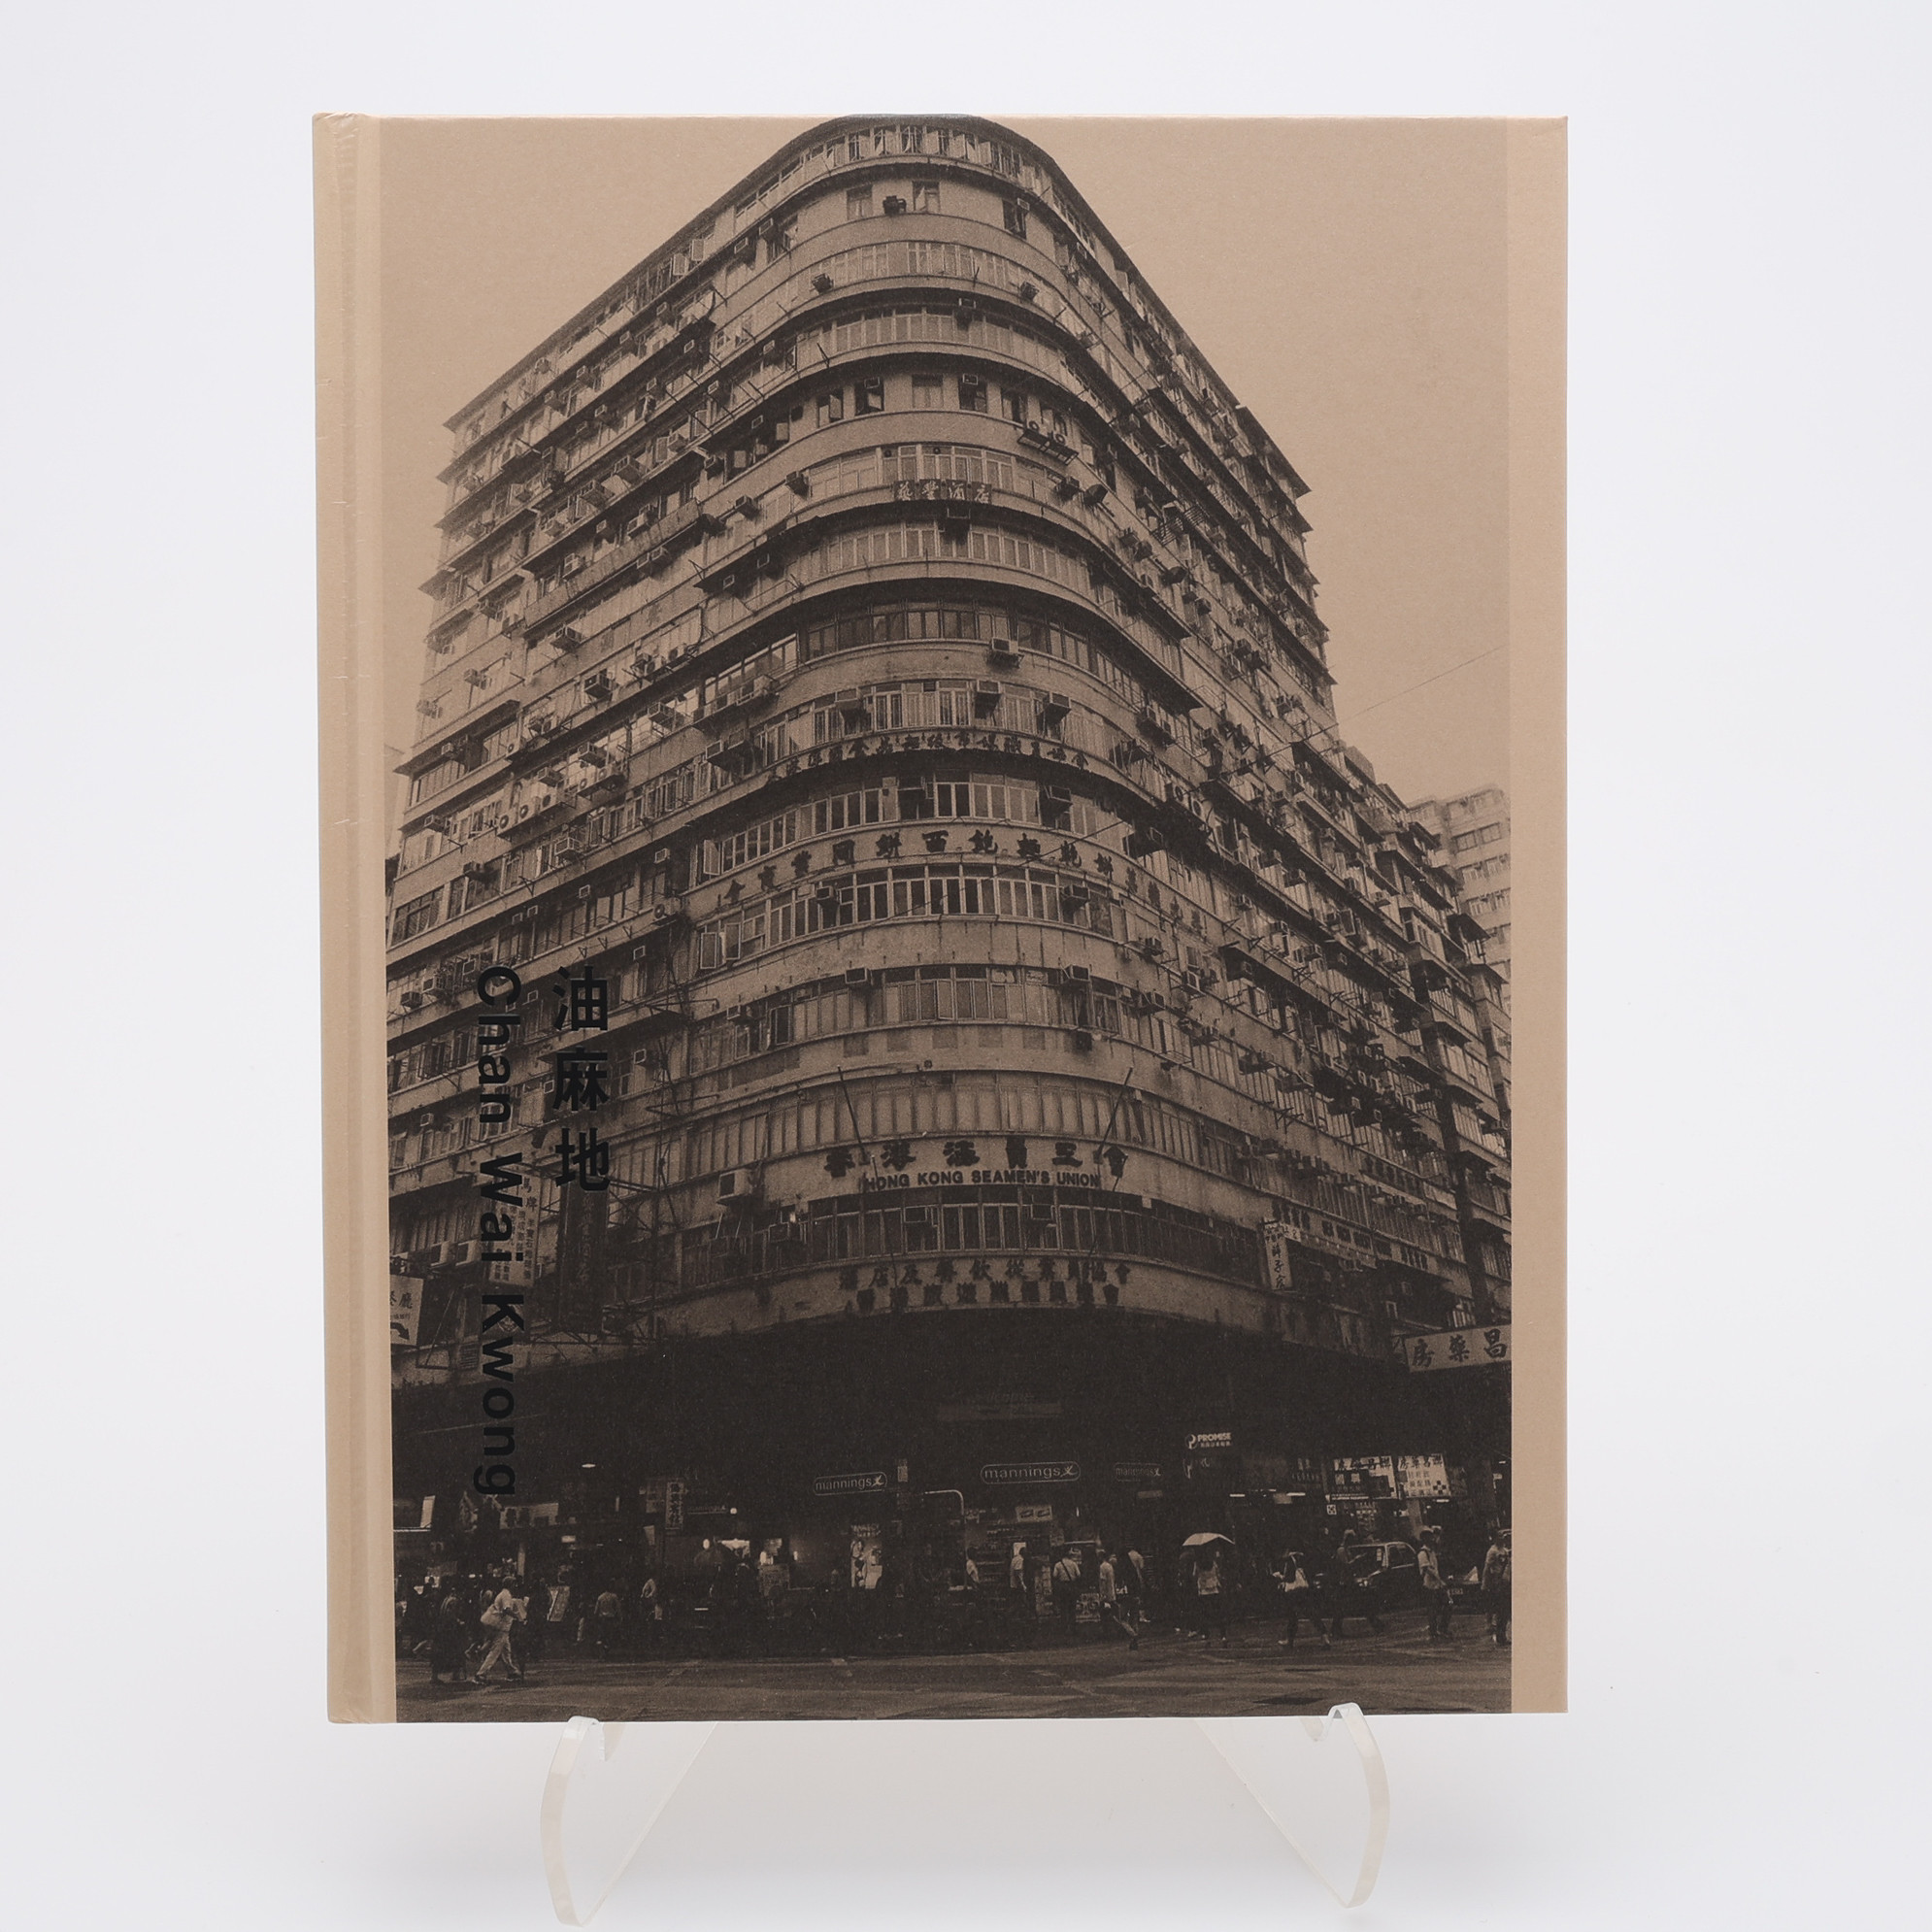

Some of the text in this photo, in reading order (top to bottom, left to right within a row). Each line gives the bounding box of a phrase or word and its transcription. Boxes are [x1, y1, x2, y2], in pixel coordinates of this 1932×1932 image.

[478, 966, 521, 1123] Chan
[552, 966, 610, 1191] 油麻地
[480, 1151, 524, 1261] Wai
[864, 1169, 1100, 1190] HONG KONG SEAMEN'S UNION
[473, 1295, 525, 1496] Kwong
[1197, 1432, 1231, 1442] PROMISE
[816, 1476, 872, 1490] mannings
[984, 1465, 1061, 1479] mannings
